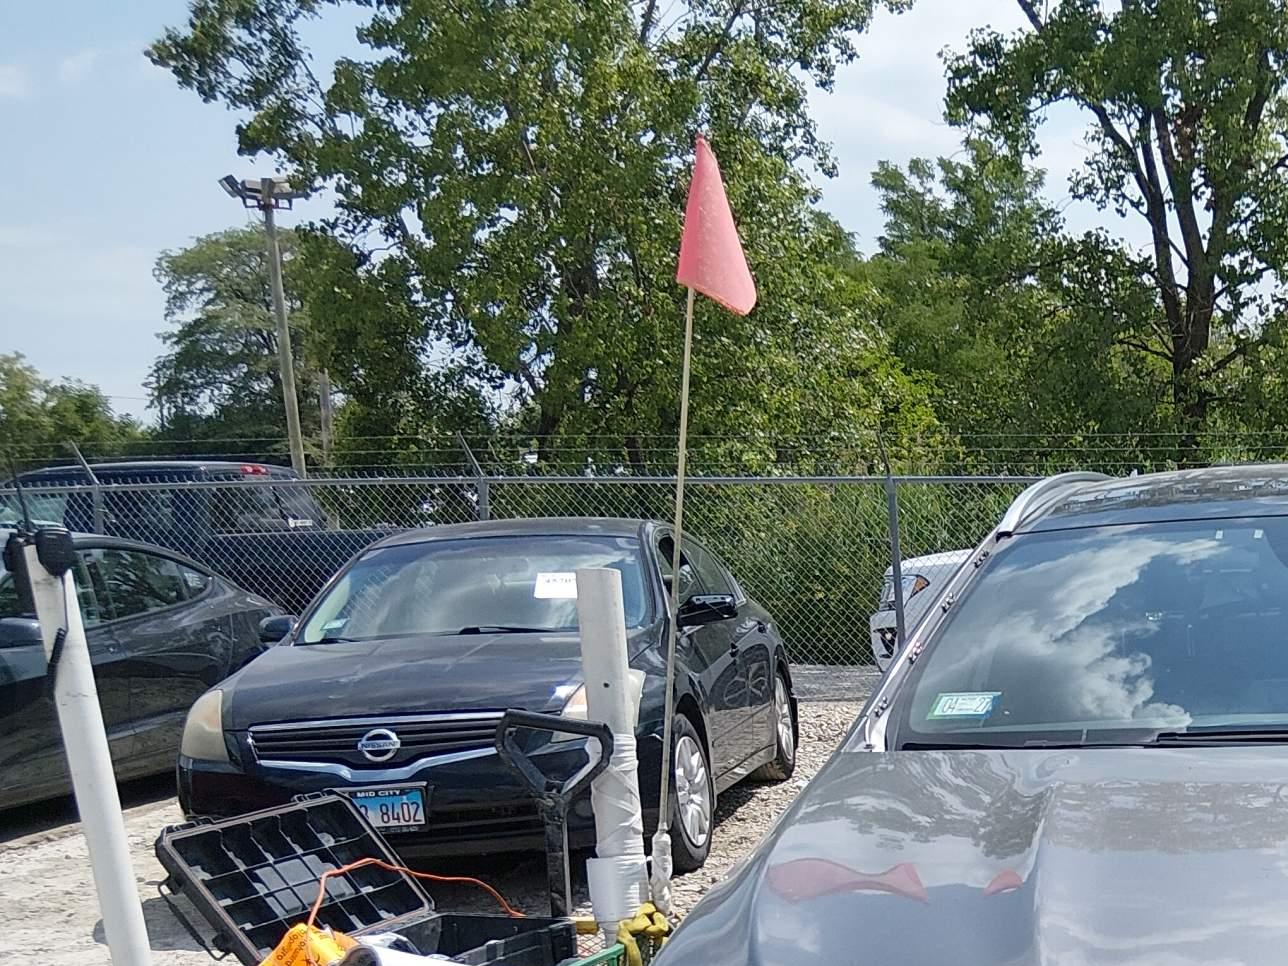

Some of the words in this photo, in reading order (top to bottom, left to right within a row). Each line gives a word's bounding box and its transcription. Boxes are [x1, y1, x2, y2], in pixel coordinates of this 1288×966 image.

[361, 740, 396, 750] NISSAN
[356, 790, 376, 798] MID
[378, 789, 401, 797] CITY
[379, 801, 423, 824] 8402
